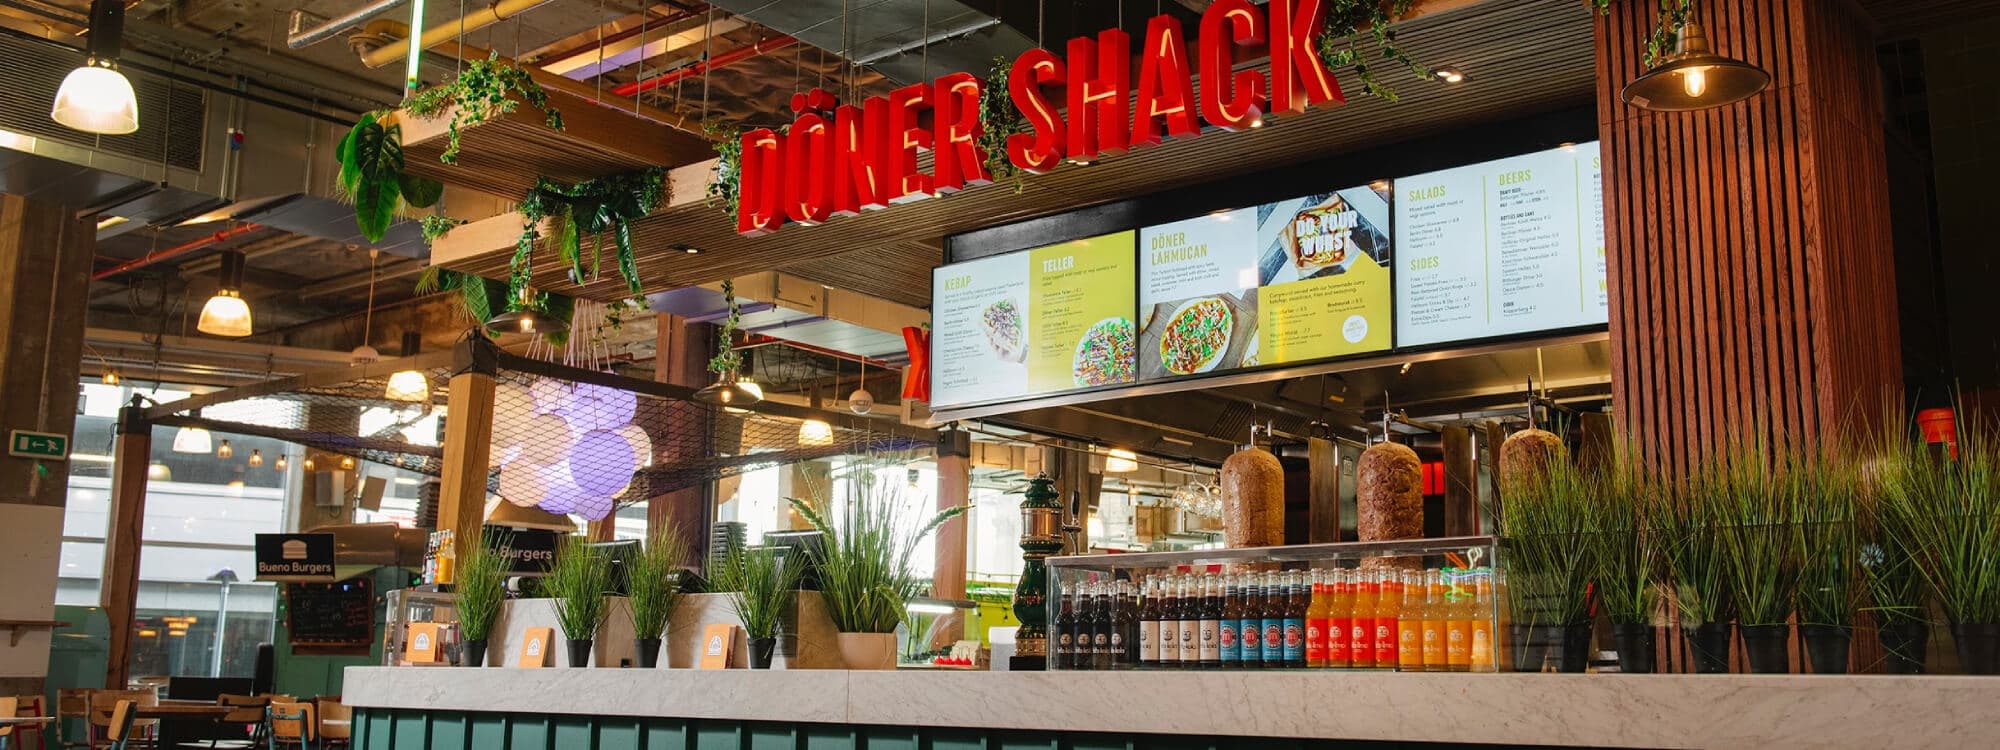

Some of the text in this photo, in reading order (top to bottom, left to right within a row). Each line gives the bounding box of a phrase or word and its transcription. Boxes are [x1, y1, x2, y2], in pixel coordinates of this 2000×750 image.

[738, 0, 1346, 236] DÖNER SHACK
[1500, 169, 1531, 186] BEERS
[1409, 184, 1446, 202] SALADS
[1296, 209, 1359, 237] DO YOUR
[1151, 232, 1185, 251] DÖNER
[1301, 229, 1353, 255] WURST
[1151, 243, 1208, 266] LAHMUCAN
[1410, 255, 1439, 272] SIDES
[1043, 256, 1074, 273] TELLER
[944, 274, 972, 292] KEBAP
[500, 545, 553, 562] Burgers
[258, 562, 332, 574] Bueno Burgers
